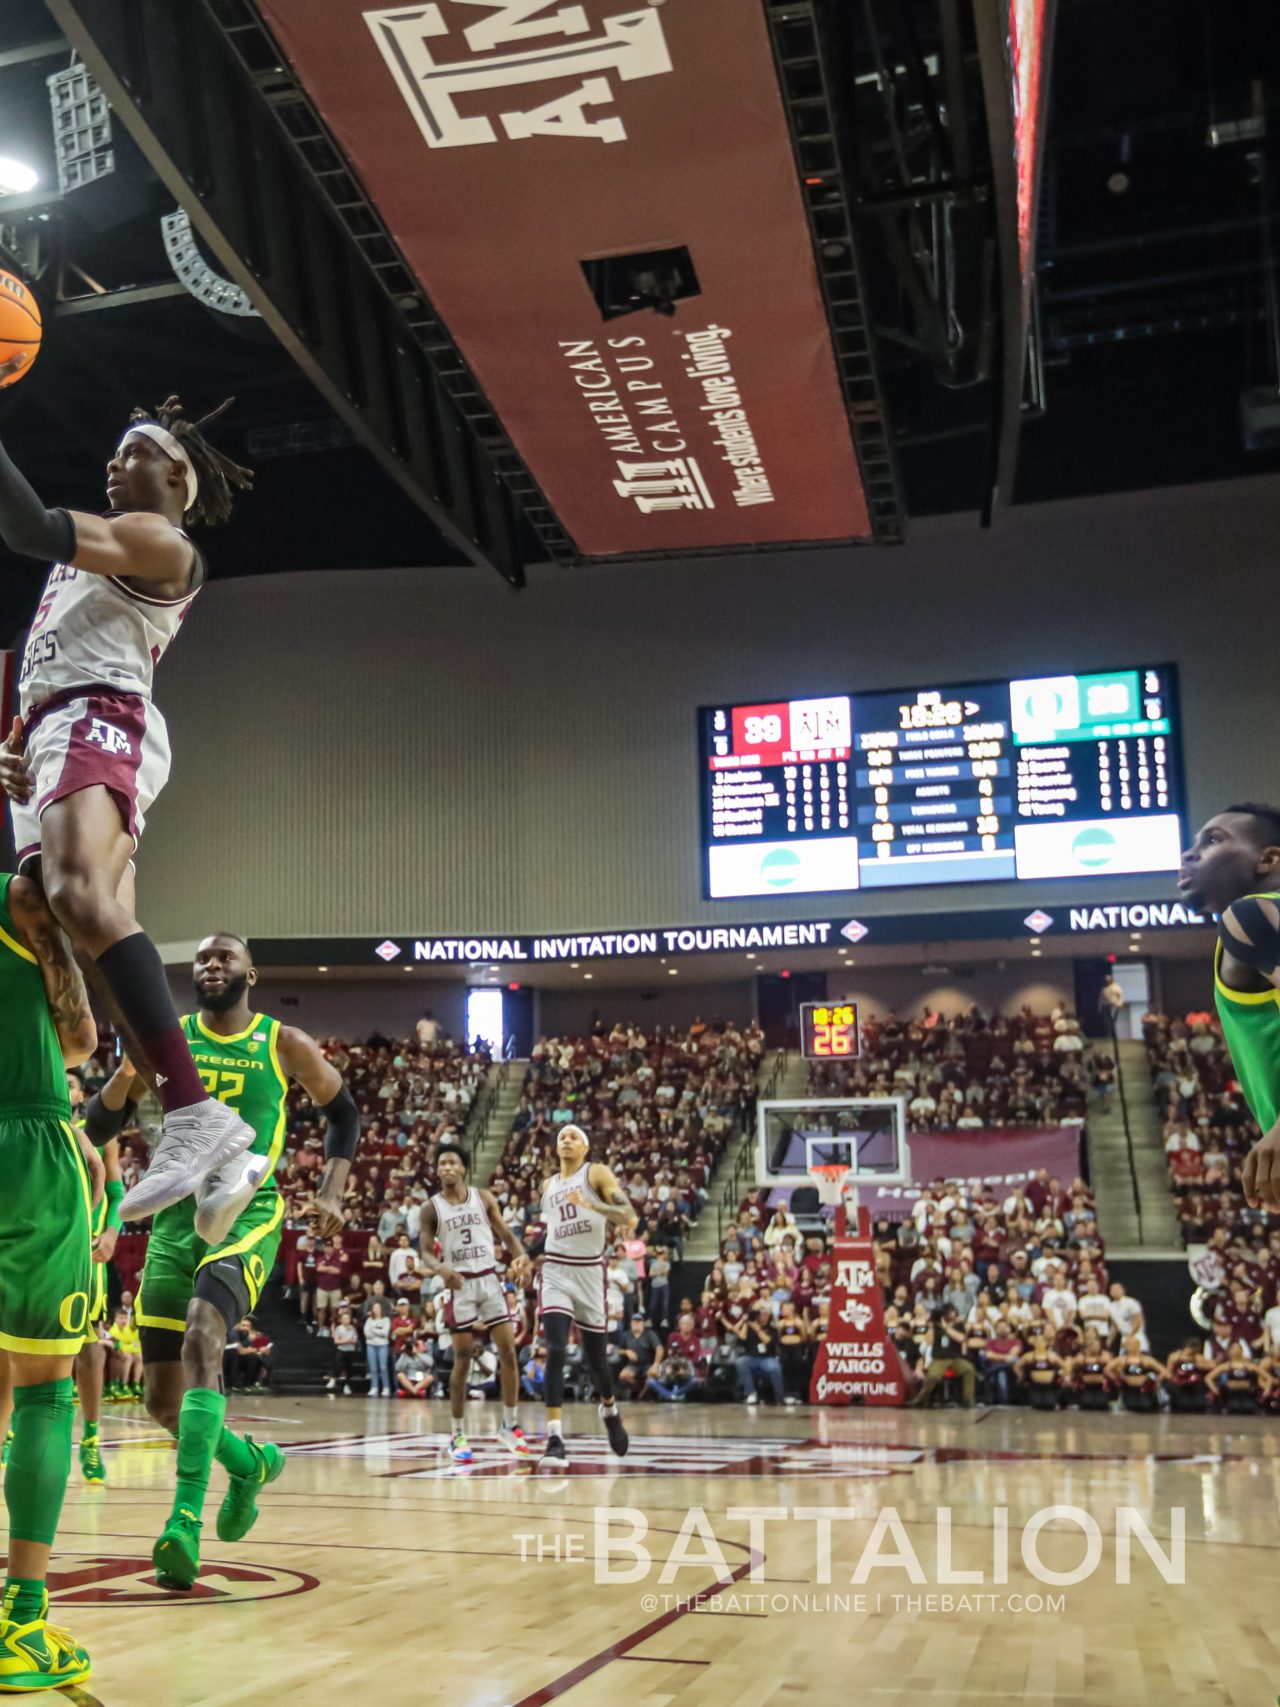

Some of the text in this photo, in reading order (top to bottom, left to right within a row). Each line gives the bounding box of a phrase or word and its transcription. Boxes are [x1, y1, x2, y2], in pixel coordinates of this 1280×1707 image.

[680, 324, 733, 378] living.
[558, 340, 645, 455] AMERICAN
[607, 336, 687, 452] CAMPUS
[699, 375, 742, 411] love
[708, 408, 762, 467] students
[414, 923, 831, 960] NATIONAL INVITATION TOURNAMENT
[814, 1024, 851, 1056] 26
[445, 1212, 482, 1232] TEXAS
[559, 1203, 578, 1222] 10
[459, 1229, 472, 1245] 3
[554, 1219, 592, 1240] AGGIES
[451, 1245, 487, 1263] AGGIES
[825, 1342, 884, 1357] WELLS
[827, 1359, 885, 1374] FARGO
[816, 1374, 898, 1400] OPPORTUNE
